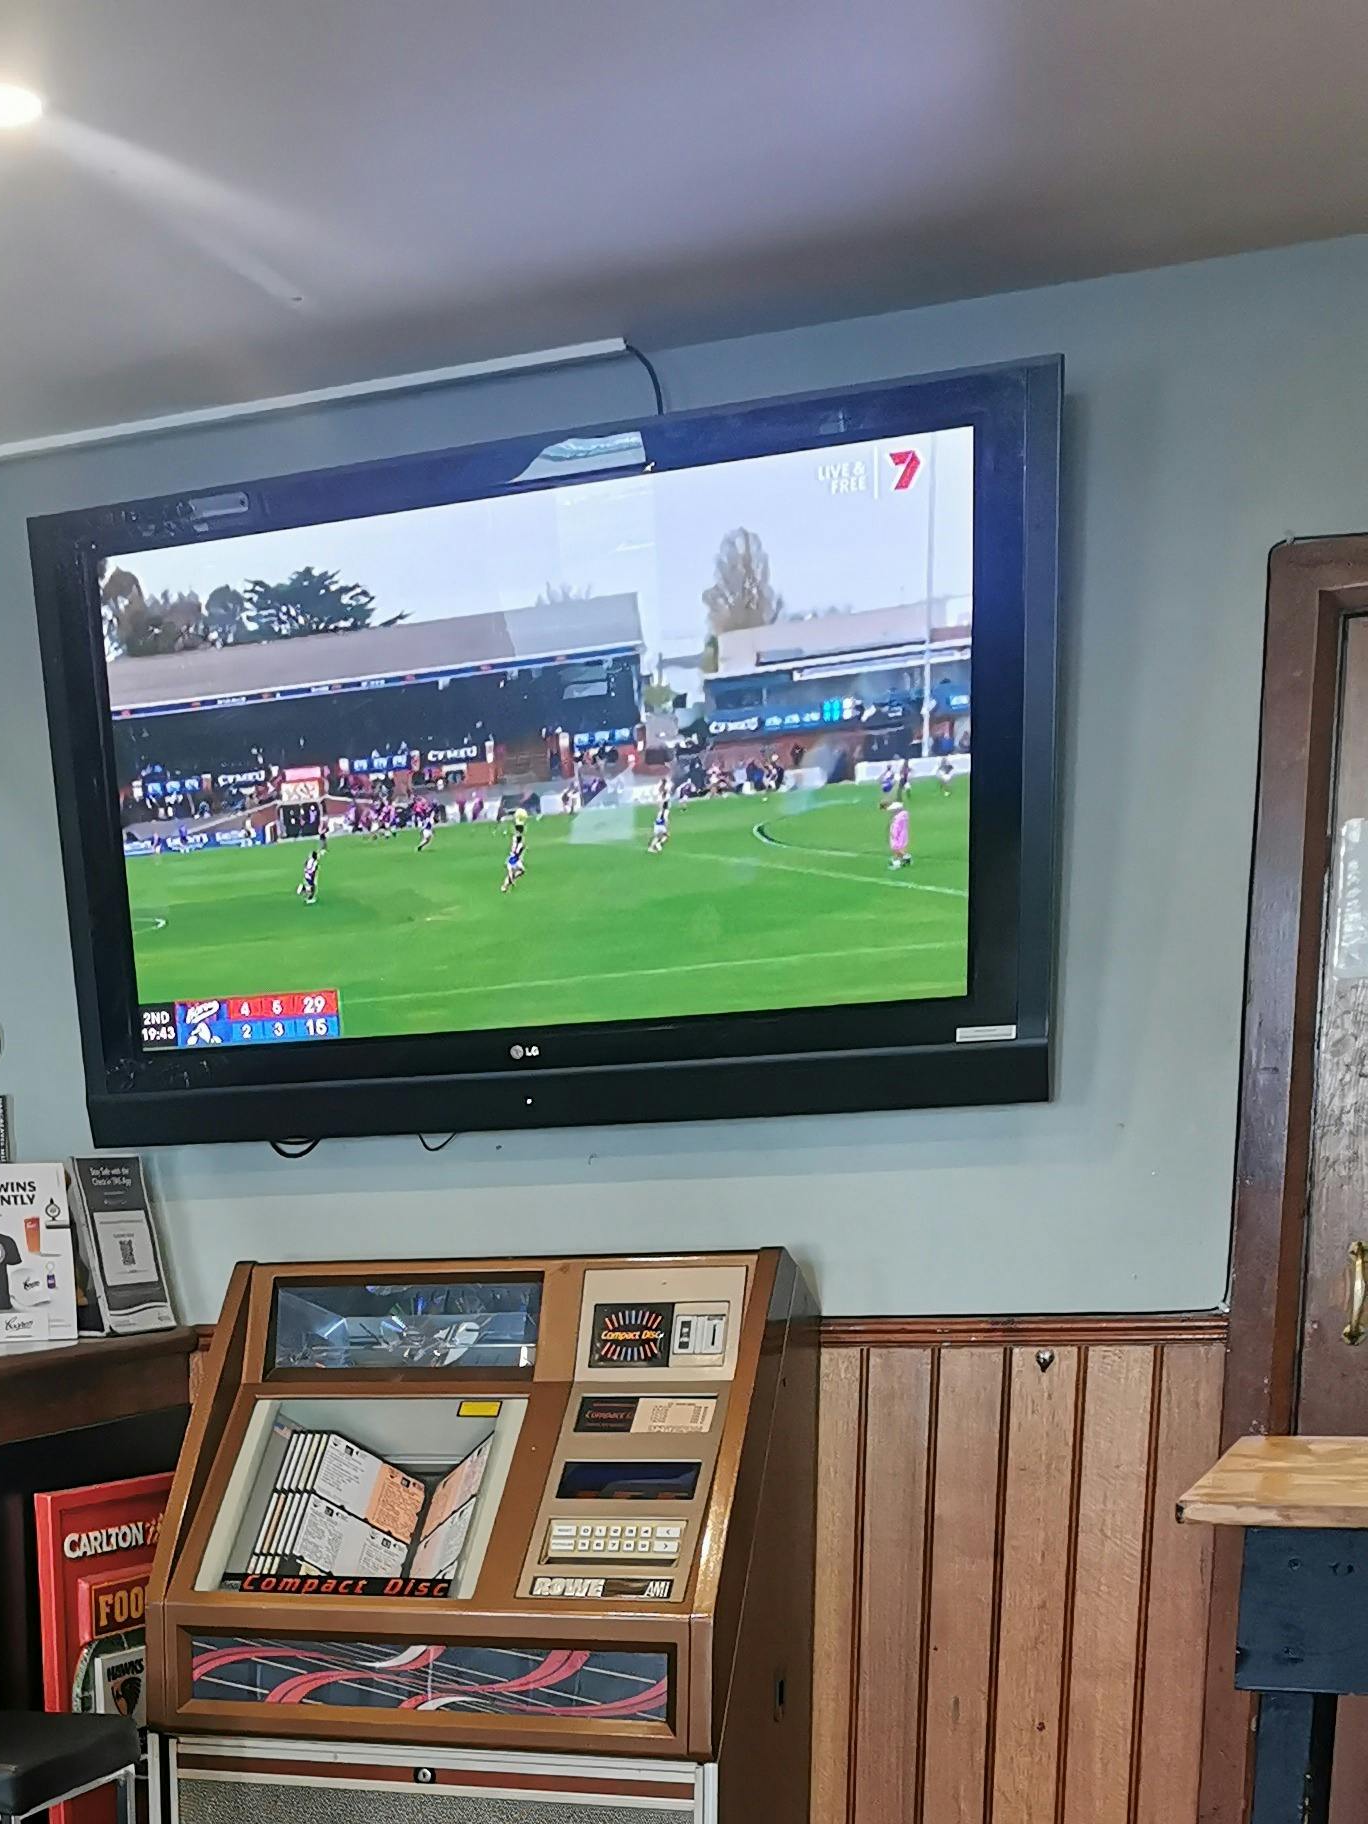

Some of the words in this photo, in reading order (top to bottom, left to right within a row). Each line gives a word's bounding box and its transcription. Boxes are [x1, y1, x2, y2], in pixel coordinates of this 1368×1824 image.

[817, 462, 850, 481] LIVE
[889, 450, 921, 491] 7
[830, 475, 868, 495] FREE
[239, 1001, 251, 1017] 4
[303, 995, 326, 1014] 29
[143, 1010, 171, 1025] 2ND
[141, 1026, 176, 1042] 19:43
[240, 1023, 253, 1039] 2
[273, 1022, 285, 1037] 3
[524, 1046, 540, 1057] LG
[1, 1181, 37, 1194] WINS
[601, 1329, 640, 1341] Compact
[641, 1330, 662, 1340] Disc
[63, 1521, 145, 1560] CARLTON
[242, 1574, 368, 1595] Compact
[383, 1578, 450, 1597] Disc
[532, 1577, 606, 1597] ROWE
[644, 1580, 671, 1598] AMI
[98, 1585, 147, 1628] FOO
[106, 1657, 145, 1683] HAWKS
